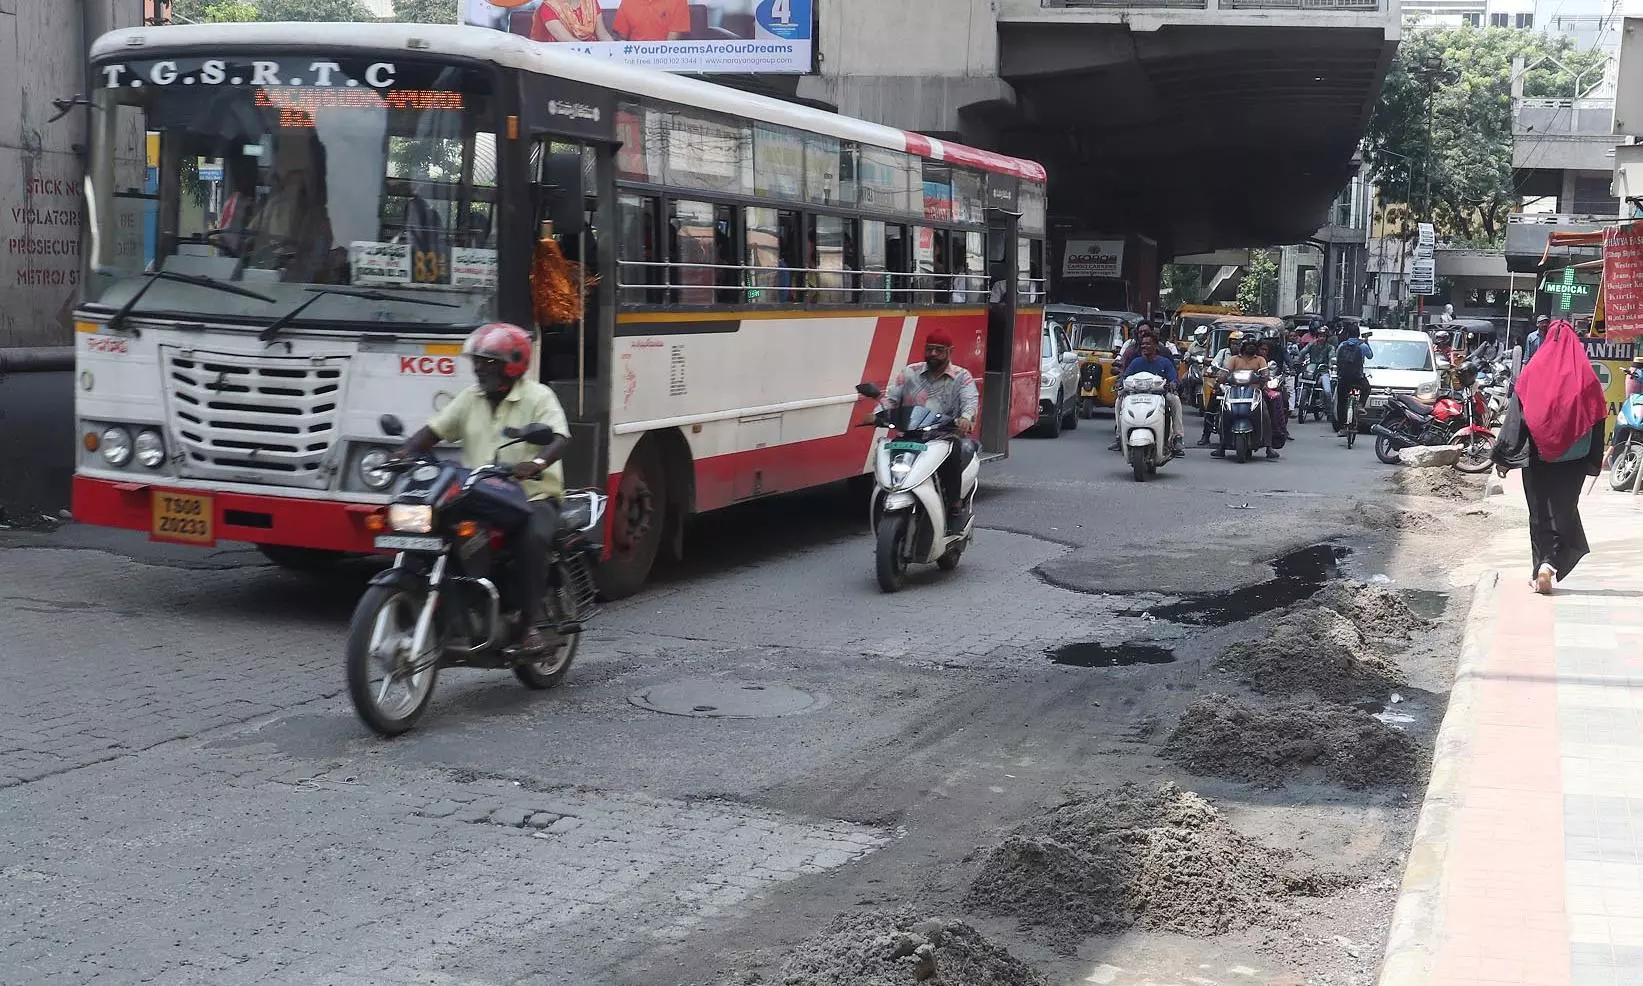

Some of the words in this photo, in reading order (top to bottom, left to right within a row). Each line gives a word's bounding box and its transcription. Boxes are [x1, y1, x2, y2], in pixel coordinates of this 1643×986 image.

[771, 0, 792, 23] 4
[624, 44, 793, 54] #YourDreamsAreOurDreams
[26, 179, 62, 196] STICK
[1546, 284, 1588, 295] MEDICAL
[1581, 342, 1632, 358] ANTHI
[400, 357, 455, 375] KCG
